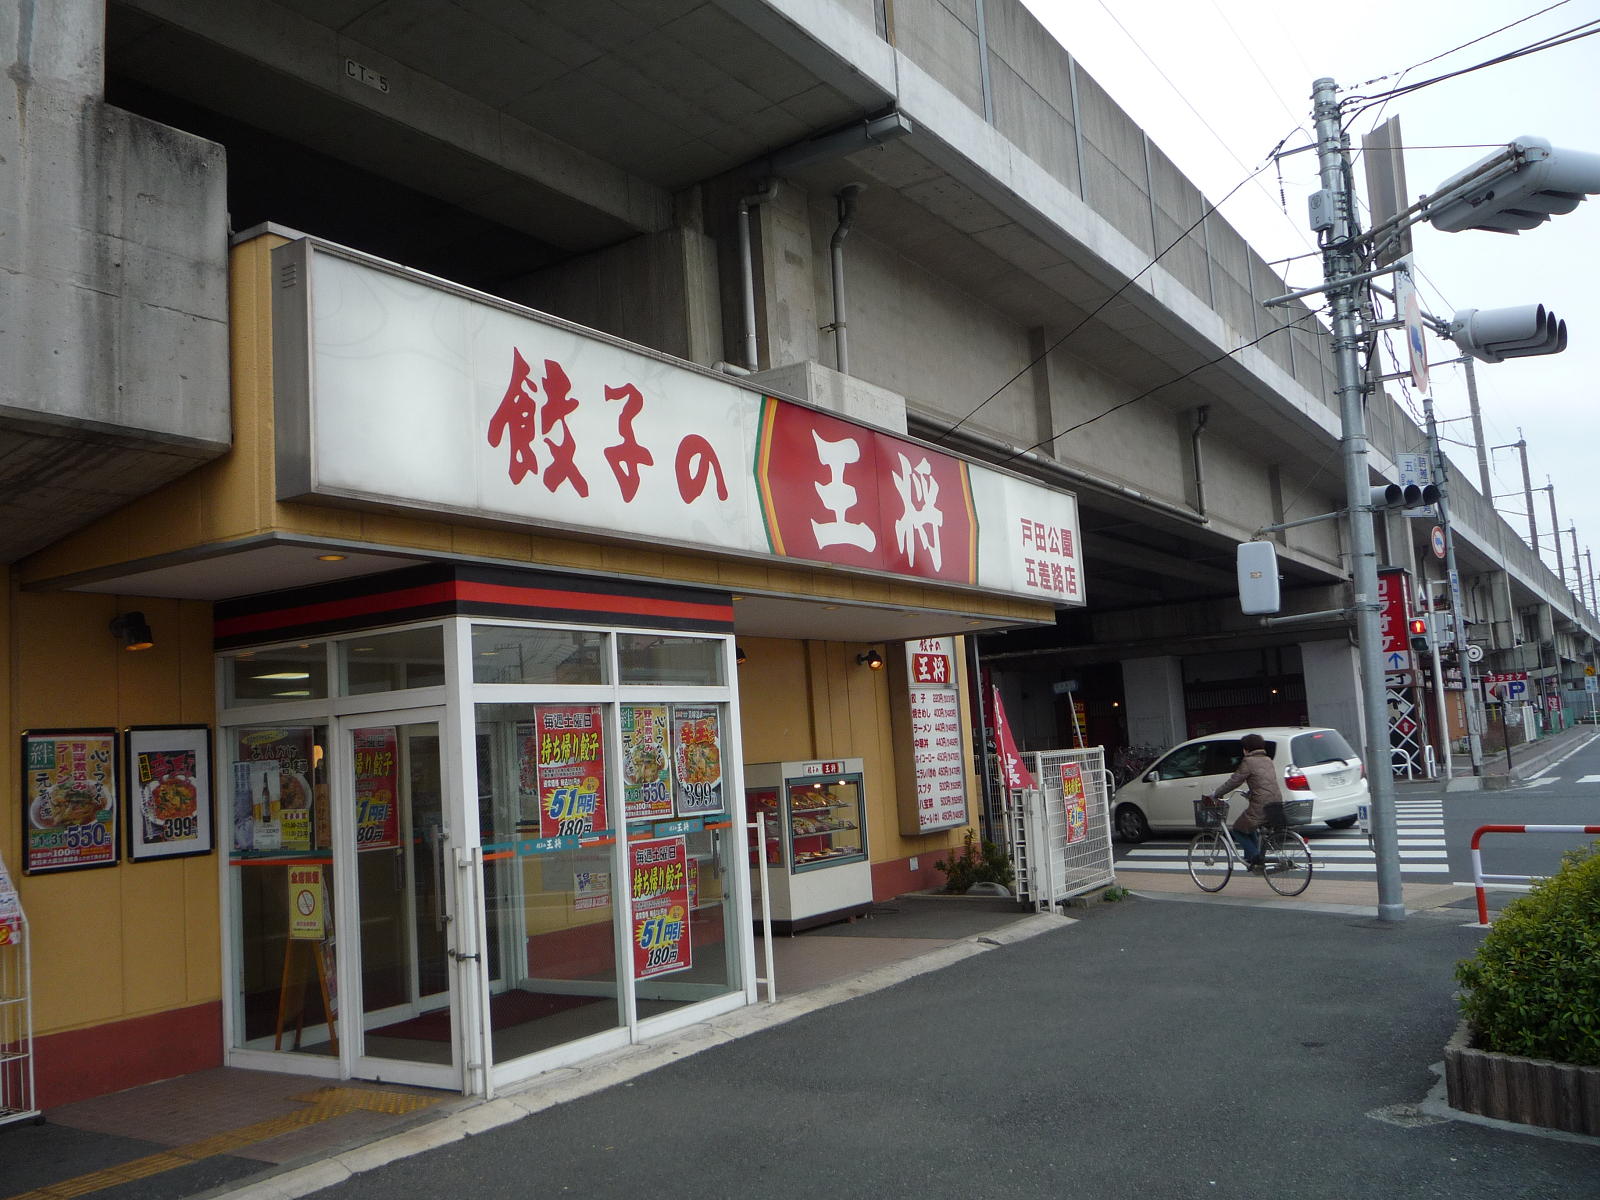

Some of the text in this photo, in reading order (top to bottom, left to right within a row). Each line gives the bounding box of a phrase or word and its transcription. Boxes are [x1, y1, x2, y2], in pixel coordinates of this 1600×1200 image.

[347, 60, 388, 92] CT-5
[1020, 517, 1075, 559] 戸田公園
[1024, 557, 1078, 595] 五差路店
[918, 656, 945, 682] 王将
[1489, 674, 1523, 682] カラオケ
[1508, 681, 1526, 700] P
[543, 713, 593, 730] 毎週土曜日
[634, 710, 644, 746] ラーメン
[913, 724, 932, 734] ラーメン
[56, 743, 71, 785] ラーメン
[541, 732, 600, 764] 持ち帰り餃子
[549, 787, 597, 820] 51円引
[636, 846, 677, 865] 毎週土曜日
[633, 863, 684, 899] 持ち帰り餃子
[641, 918, 681, 950] 51円引
[647, 946, 678, 968] 180円
